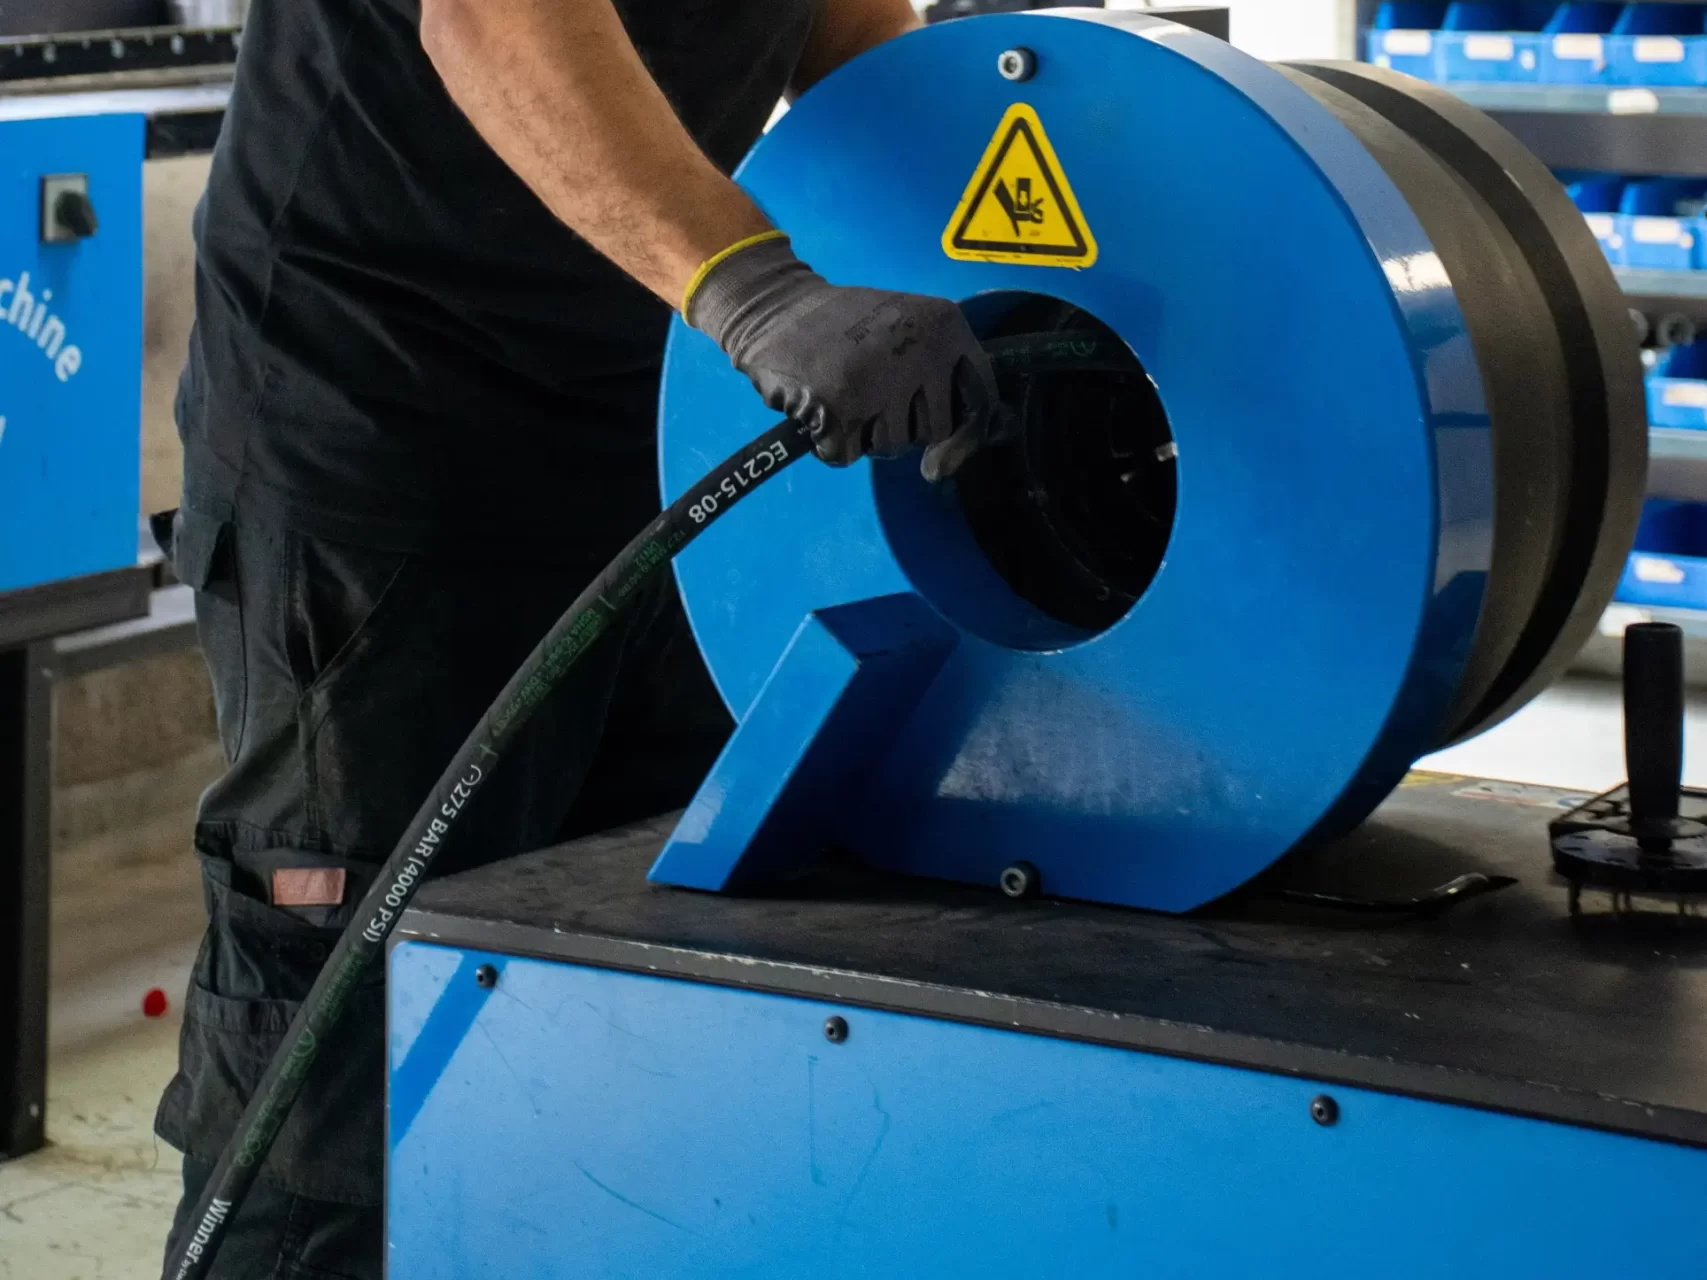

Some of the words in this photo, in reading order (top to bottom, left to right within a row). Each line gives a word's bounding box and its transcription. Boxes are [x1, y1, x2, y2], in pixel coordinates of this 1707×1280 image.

[688, 440, 789, 524] EC215-08
[441, 781, 471, 819] 275
[415, 819, 448, 857] BAR
[385, 856, 425, 907] (4000
[362, 907, 394, 943] PSI)
[186, 1197, 232, 1263] Winner
